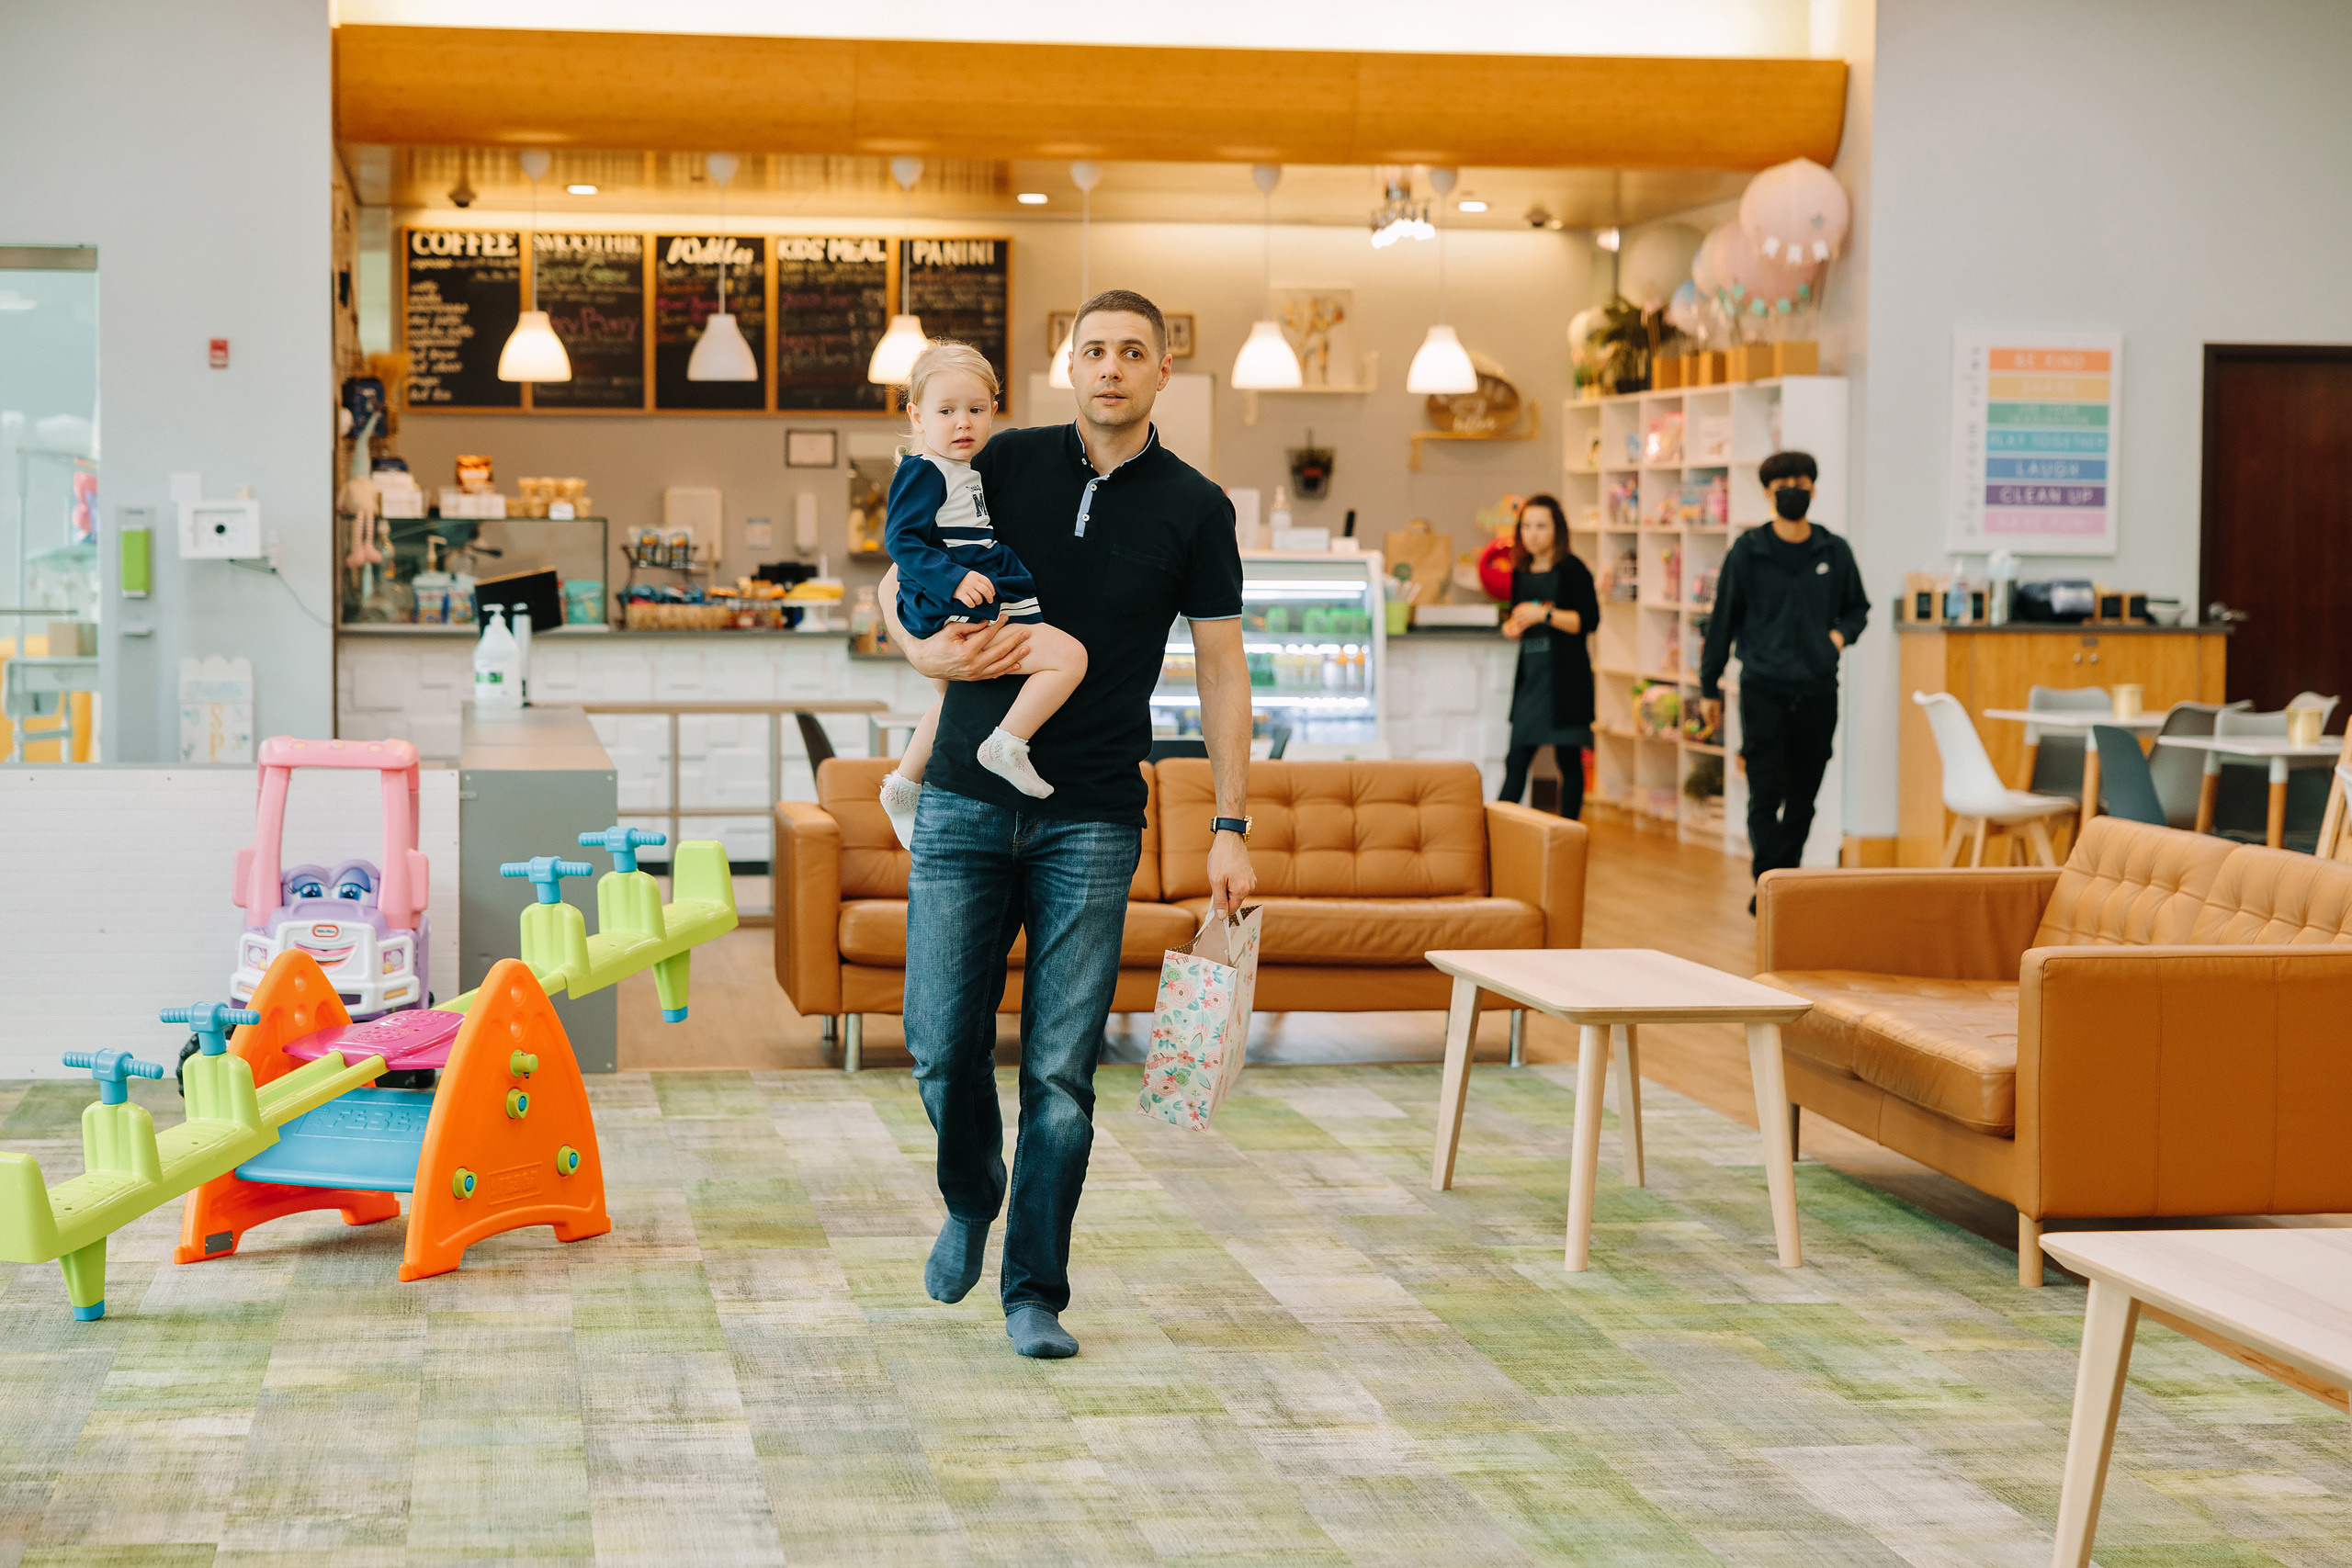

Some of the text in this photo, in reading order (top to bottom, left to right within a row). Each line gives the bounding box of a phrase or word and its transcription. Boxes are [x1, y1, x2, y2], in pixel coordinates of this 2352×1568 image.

[412, 231, 519, 257] COFFEE
[912, 240, 995, 265] PANINI
[2015, 462, 2080, 477] LAUGH
[1998, 486, 2094, 504] CLEAN UP
